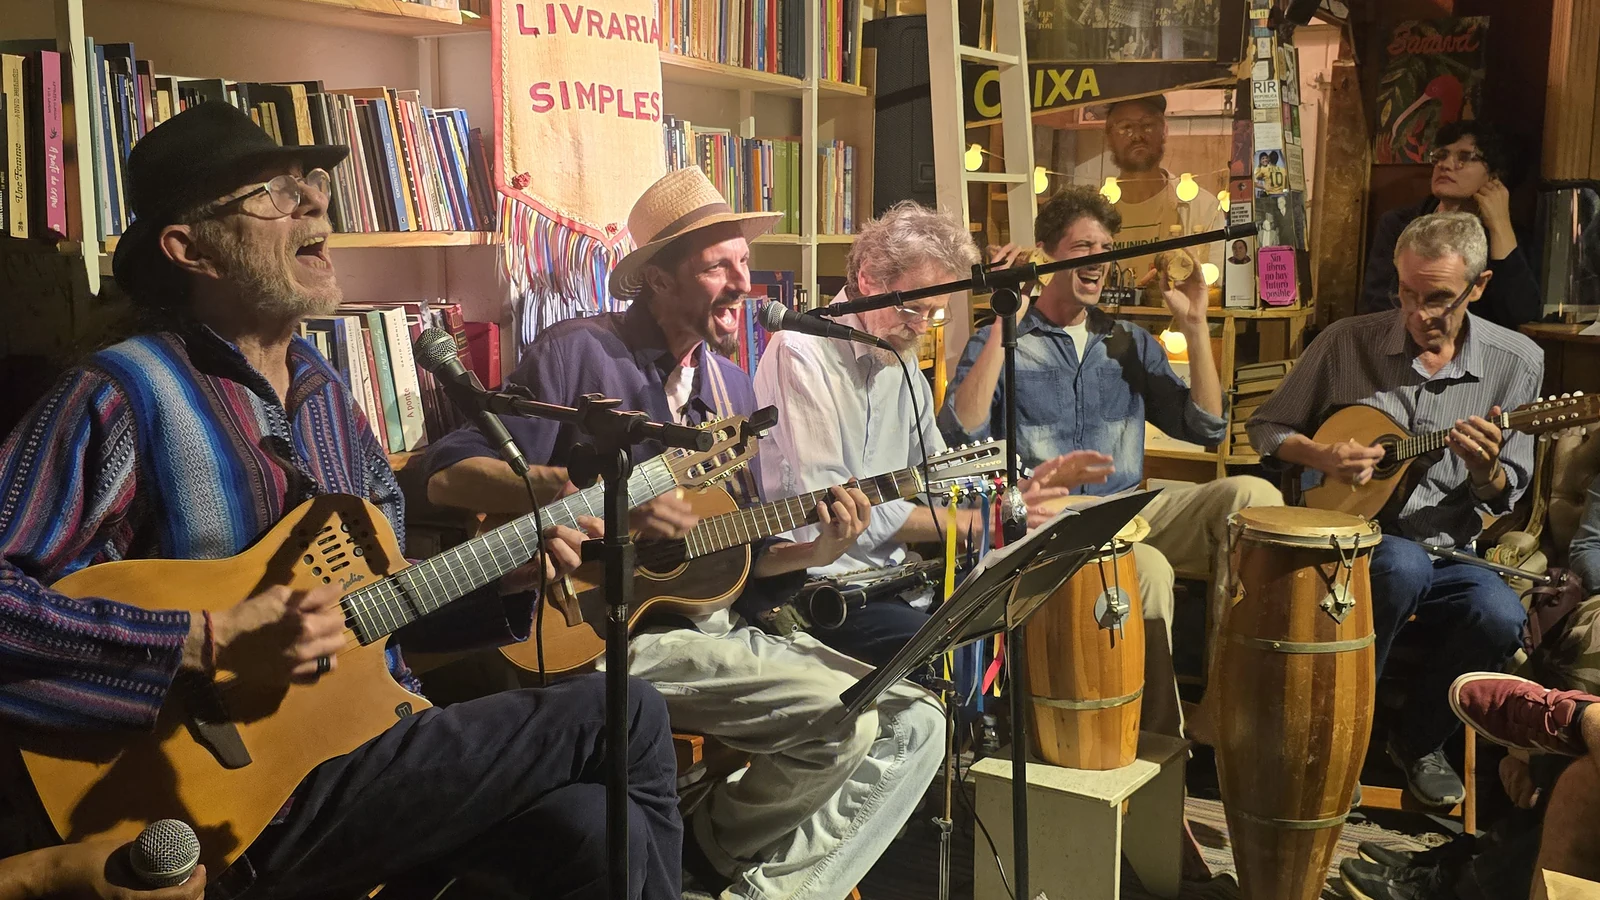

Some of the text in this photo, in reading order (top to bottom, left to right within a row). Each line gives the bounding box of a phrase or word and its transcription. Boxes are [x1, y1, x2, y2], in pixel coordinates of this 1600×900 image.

[516, 3, 660, 44] LIVRARIA
[1253, 81, 1276, 93] RIR
[974, 68, 1100, 118] CIXA
[529, 81, 660, 122] SIMPLES
[1270, 171, 1283, 187] 10
[1270, 253, 1281, 262] Sin
[1266, 263, 1286, 271] libros
[1275, 272, 1288, 280] hay
[1265, 281, 1288, 289] futuro
[1266, 290, 1291, 299] posible
[404, 387, 415, 411] ponte
[973, 459, 1002, 470] Trevo
